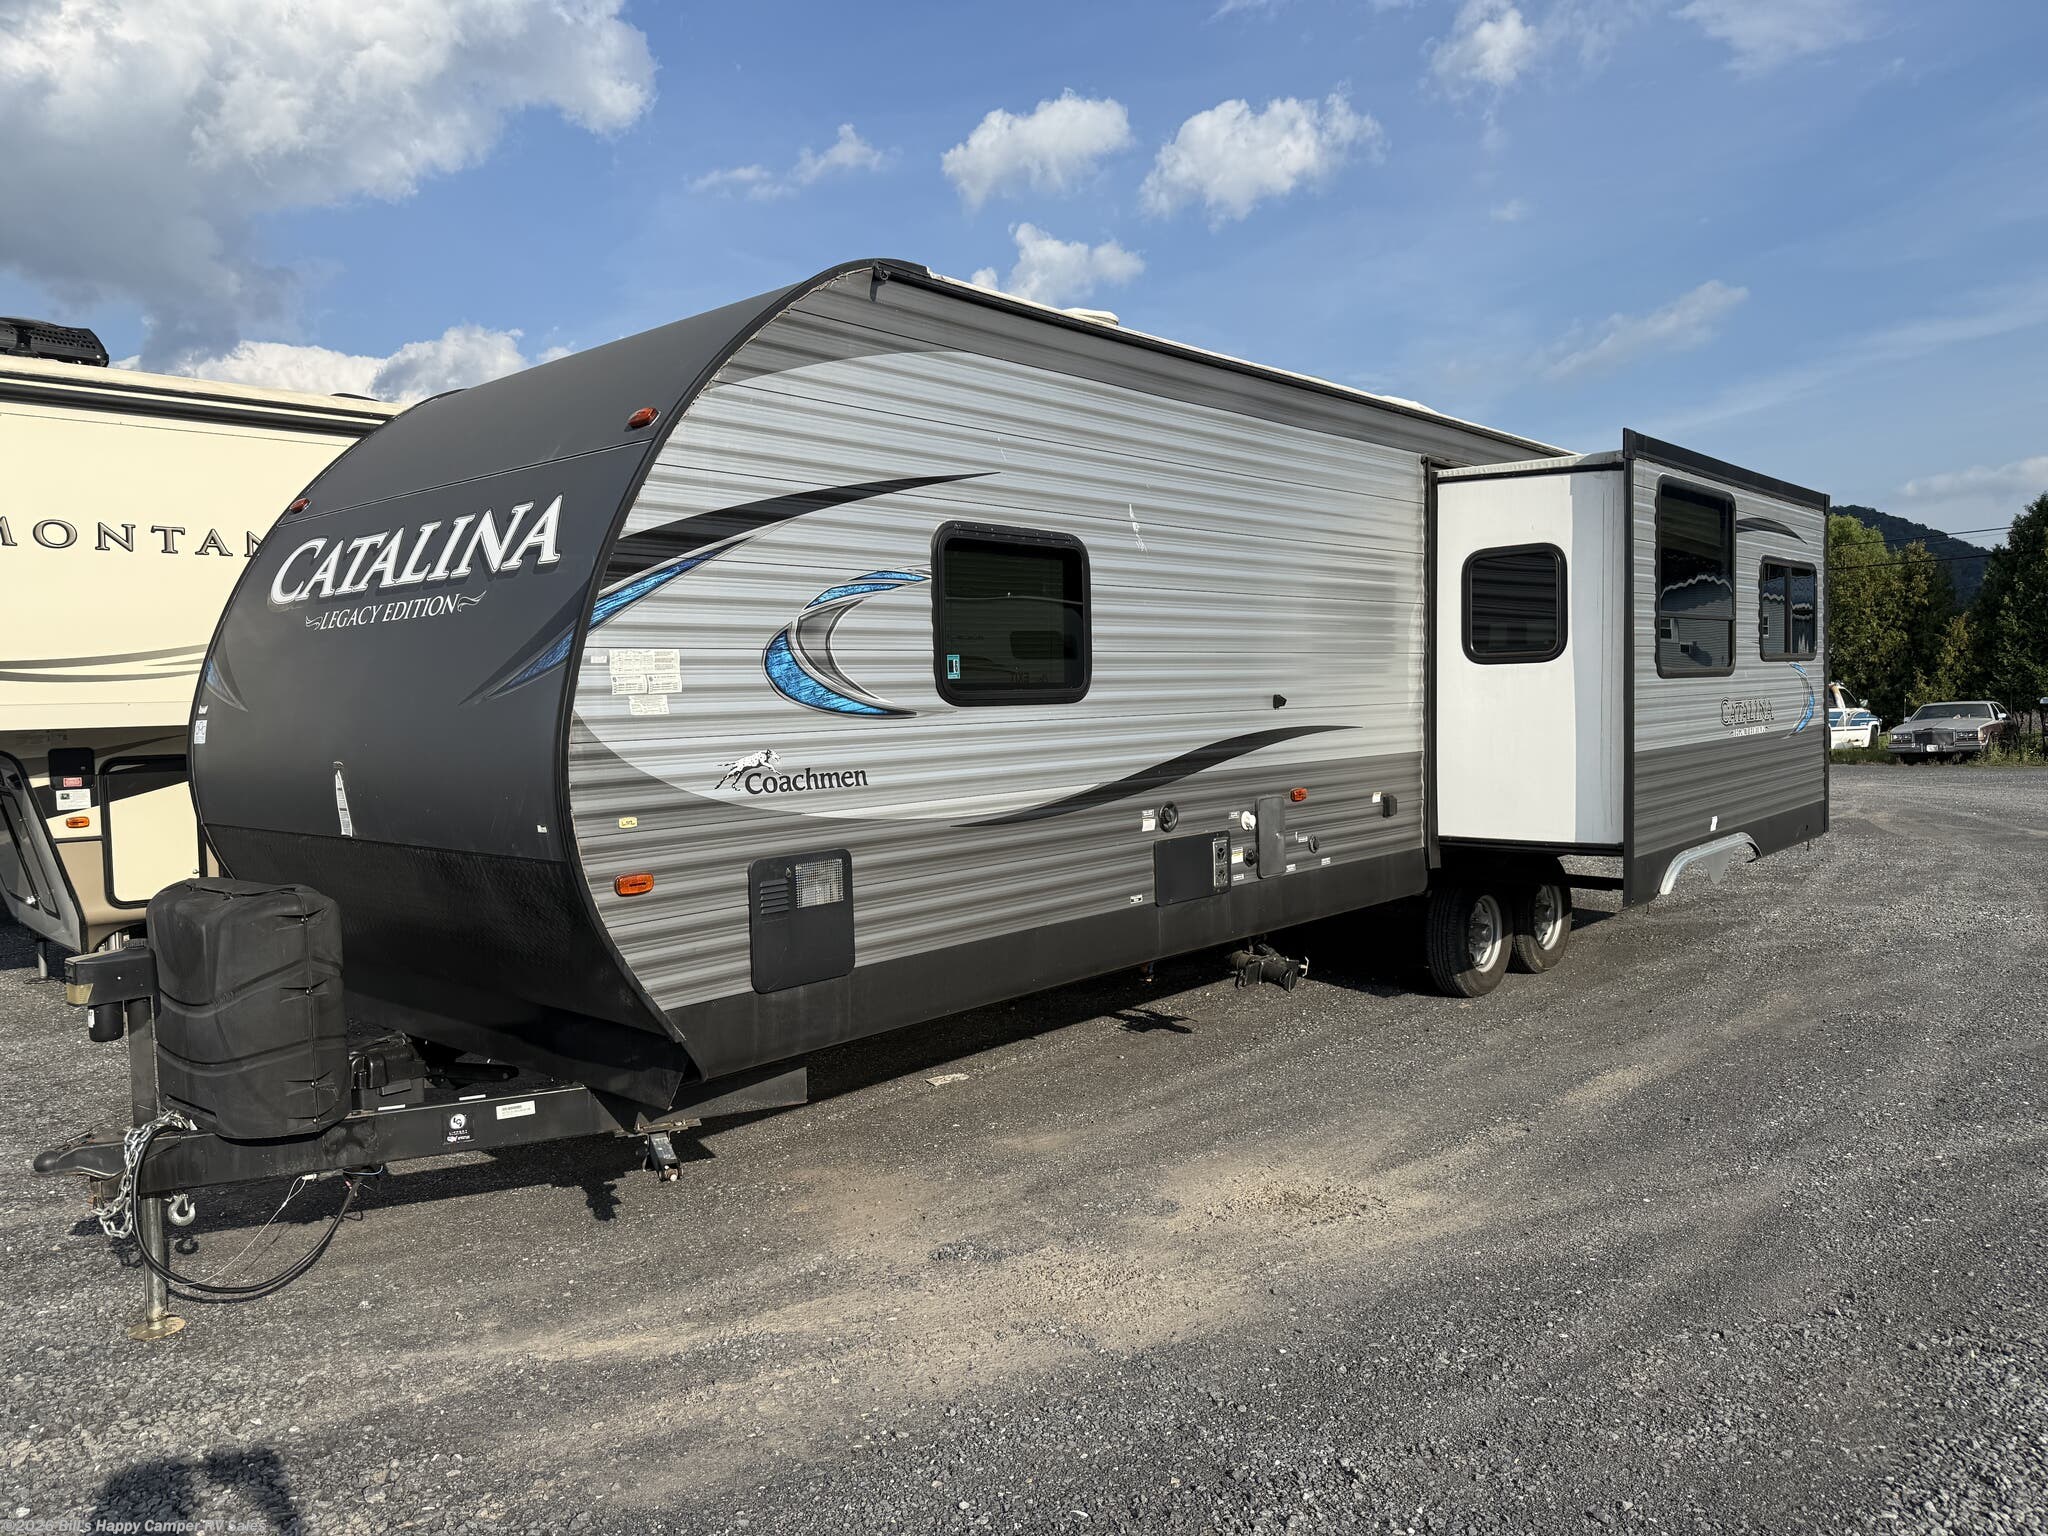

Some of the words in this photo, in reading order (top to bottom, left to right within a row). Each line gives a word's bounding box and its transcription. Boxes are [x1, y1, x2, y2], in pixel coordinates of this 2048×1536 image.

[269, 492, 564, 606] CATALINA
[320, 604, 386, 631] LEGACY
[382, 593, 460, 622] EDITION
[744, 768, 868, 795] Coachmen
